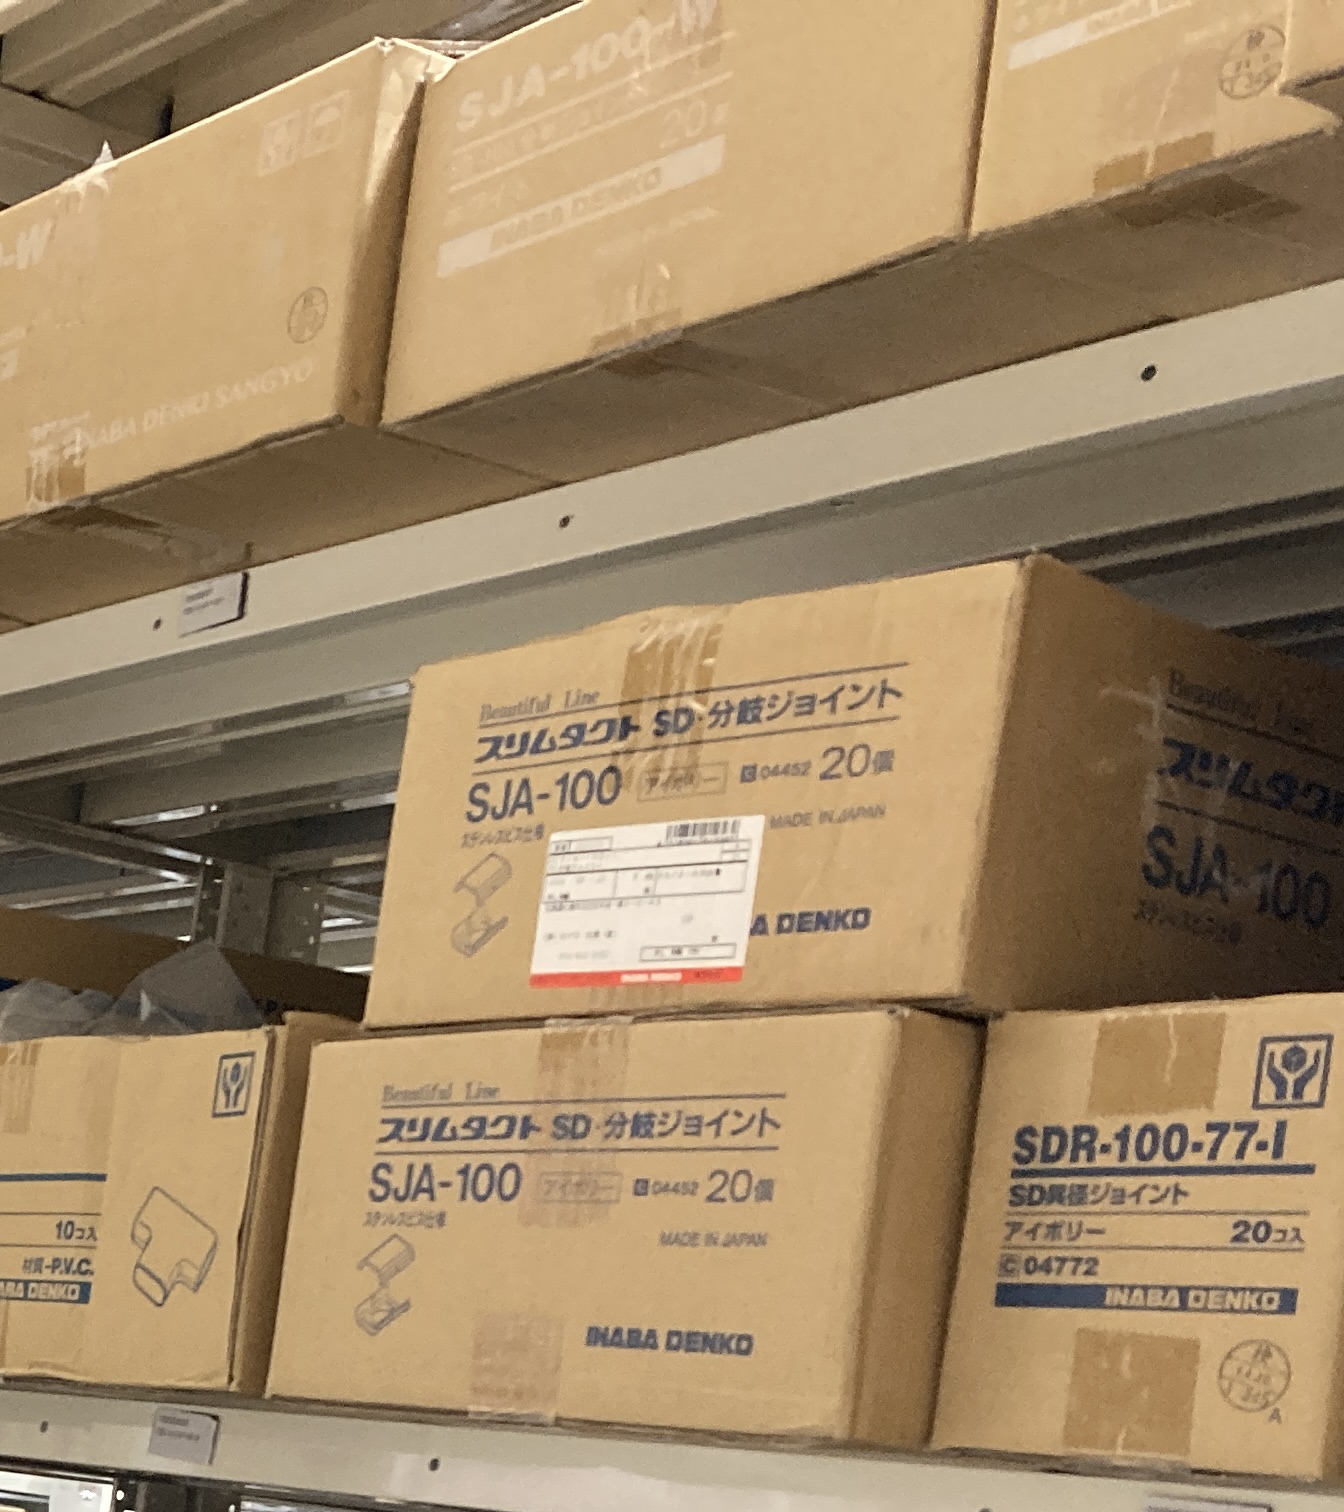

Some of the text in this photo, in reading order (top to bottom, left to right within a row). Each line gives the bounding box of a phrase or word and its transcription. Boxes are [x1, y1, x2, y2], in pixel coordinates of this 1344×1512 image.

[466, 765, 623, 824] SJA-100
[1142, 826, 1332, 929] SJA-100
[775, 906, 872, 935] DENKO
[1013, 1120, 1288, 1165] SDR-100-77-I
[368, 1162, 522, 1204] SJA-100
[1004, 1219, 1106, 1243] アイボリー
[1024, 1255, 1100, 1276] 04772
[28, 1283, 80, 1301] DENKO
[1105, 1286, 1281, 1311] INABA DENKO
[585, 1326, 754, 1355] INABA DENKO
